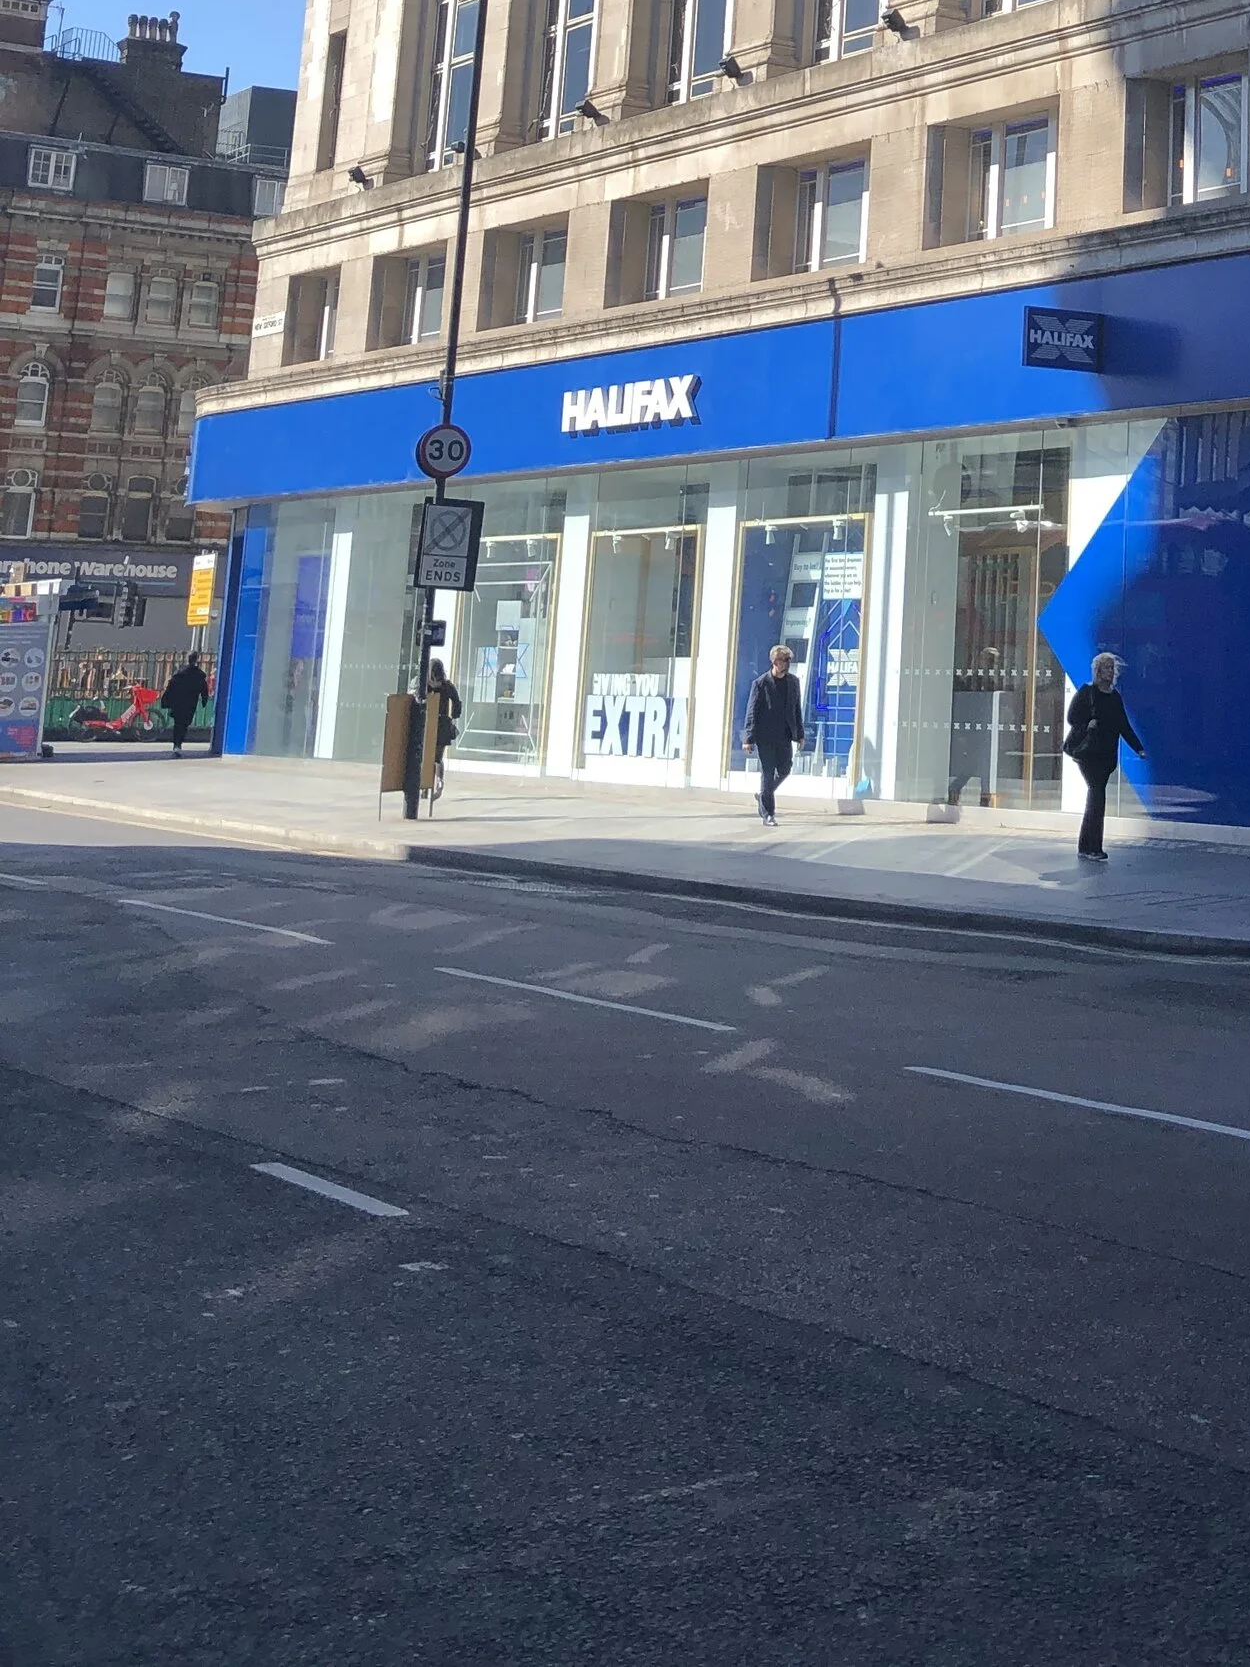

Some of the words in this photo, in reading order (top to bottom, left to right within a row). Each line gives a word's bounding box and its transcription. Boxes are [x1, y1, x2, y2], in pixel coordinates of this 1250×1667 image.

[1029, 328, 1095, 349] HALIFAX
[561, 373, 697, 434] HALIFAX
[428, 439, 465, 461] 30
[74, 561, 178, 579] Warehouse
[433, 558, 456, 569] Zone
[425, 570, 461, 583] ENDS
[635, 673, 660, 697] YOU
[584, 695, 690, 760] EXTRA
